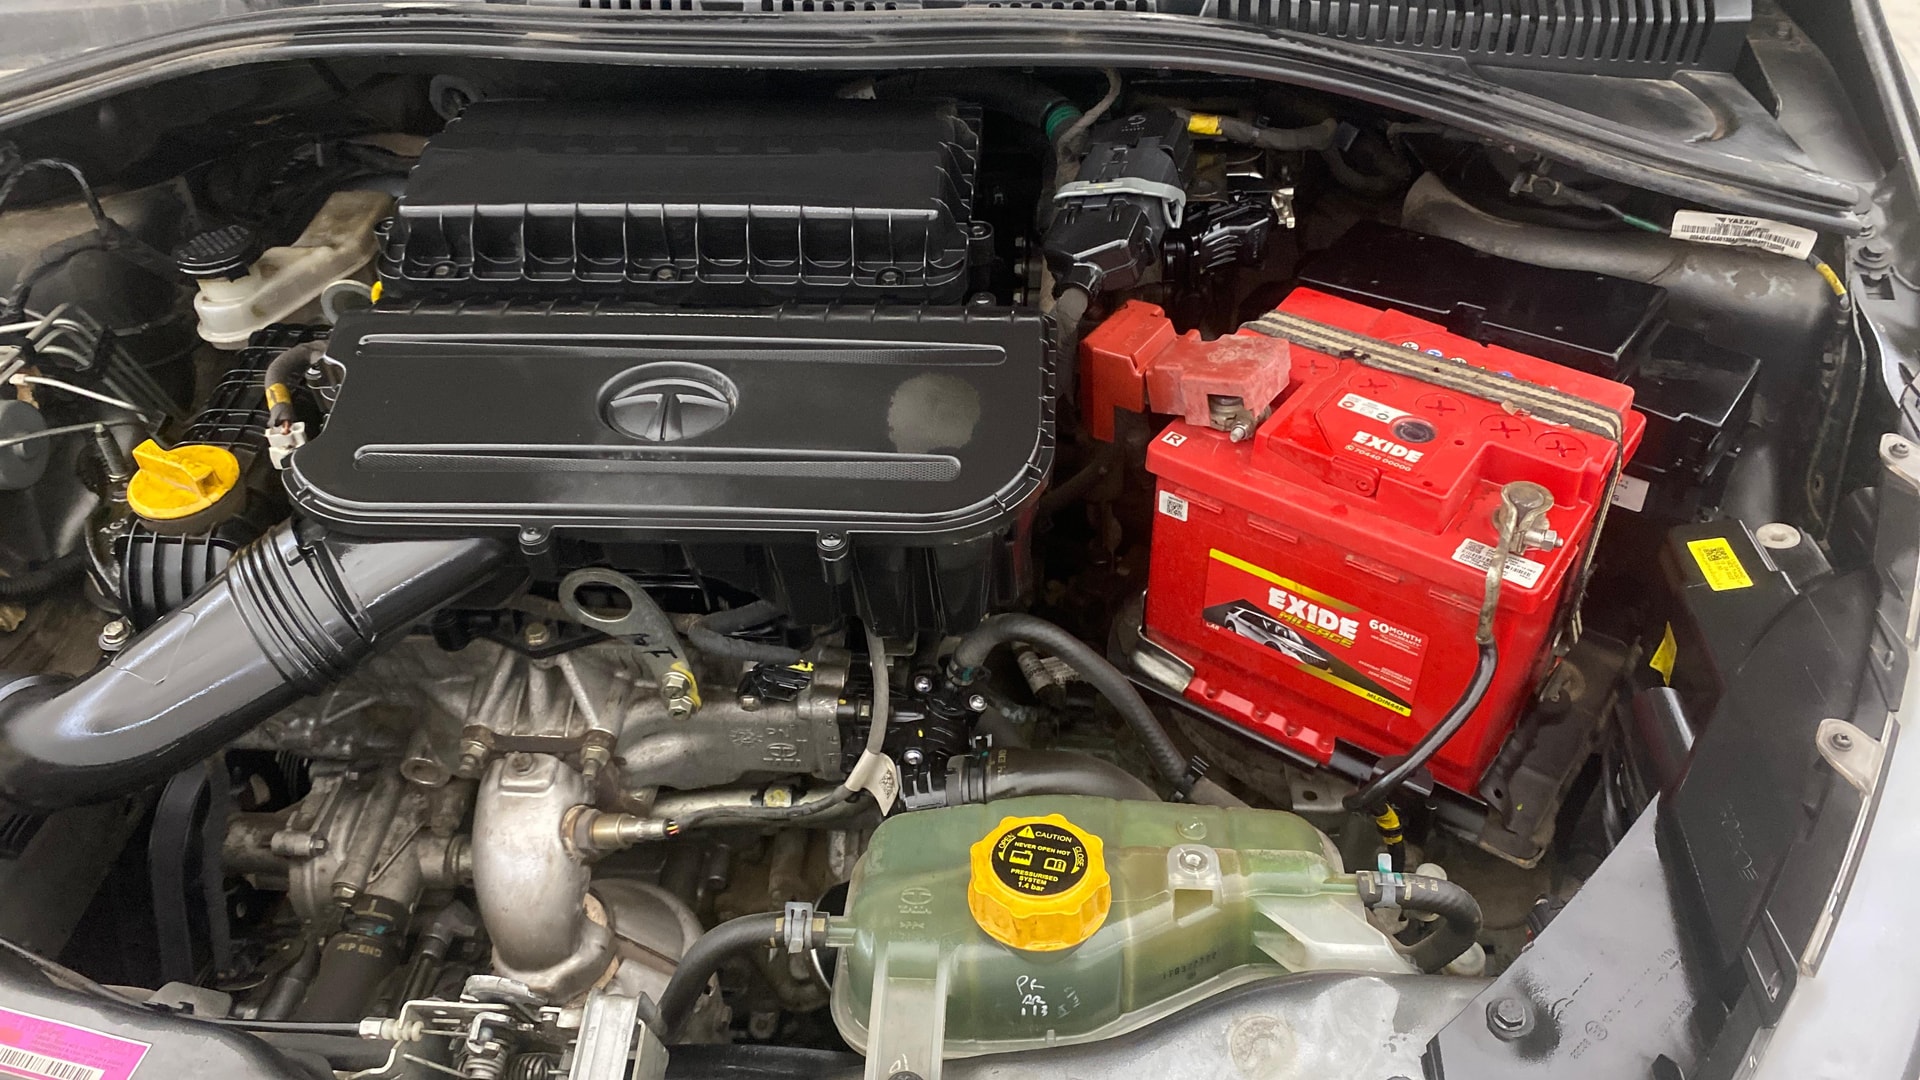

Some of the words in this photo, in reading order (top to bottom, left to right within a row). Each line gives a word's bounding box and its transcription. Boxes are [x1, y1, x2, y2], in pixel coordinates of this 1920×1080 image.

[1728, 217, 1758, 226] YAZAKI
[1166, 433, 1182, 444] R
[1352, 430, 1424, 463] EXIDE
[1267, 587, 1360, 641] EXIDE
[1277, 611, 1355, 649] MILEAGE
[1389, 626, 1422, 644] MONTH
[998, 833, 1015, 849] OPEN
[1035, 831, 1072, 843] CAUTION
[1015, 841, 1036, 850] NEVER
[1037, 845, 1055, 853] OPEN
[1074, 846, 1085, 867] CLOSE
[1010, 868, 1058, 882] PRESSURISED
[1019, 875, 1047, 885] SYSTEM
[1031, 882, 1045, 892] bar
